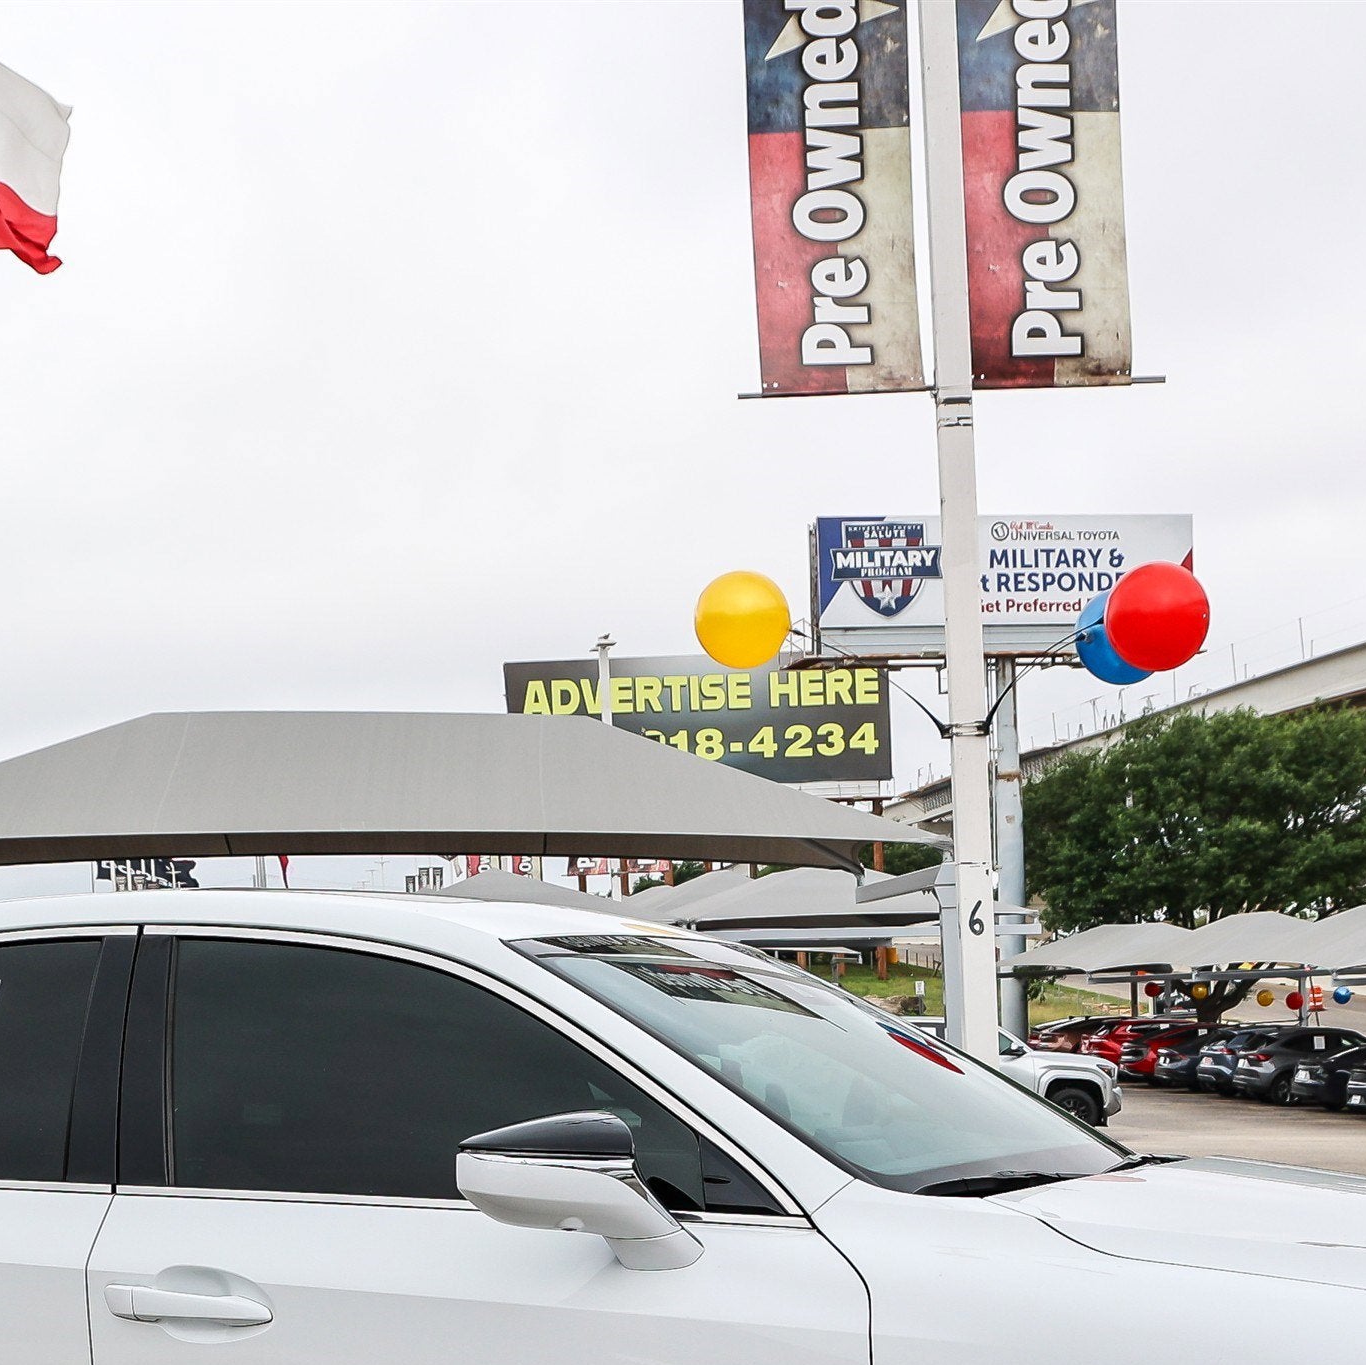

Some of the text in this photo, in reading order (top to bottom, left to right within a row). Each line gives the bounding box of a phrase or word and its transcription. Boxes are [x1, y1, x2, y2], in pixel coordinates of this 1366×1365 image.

[785, 0, 872, 366] Pre Owned
[1012, 240, 1082, 356] Pre
[863, 530, 906, 538] SALUTE
[1010, 530, 1120, 541] UNIVERSAL TOYOTA
[836, 549, 936, 569] MILITARY
[989, 548, 1125, 569] MILITARY &
[860, 567, 913, 577] PROGRAM
[981, 598, 1082, 613] et Preferred
[523, 668, 879, 715] ADVERTISE HERE
[969, 900, 984, 936] 6
